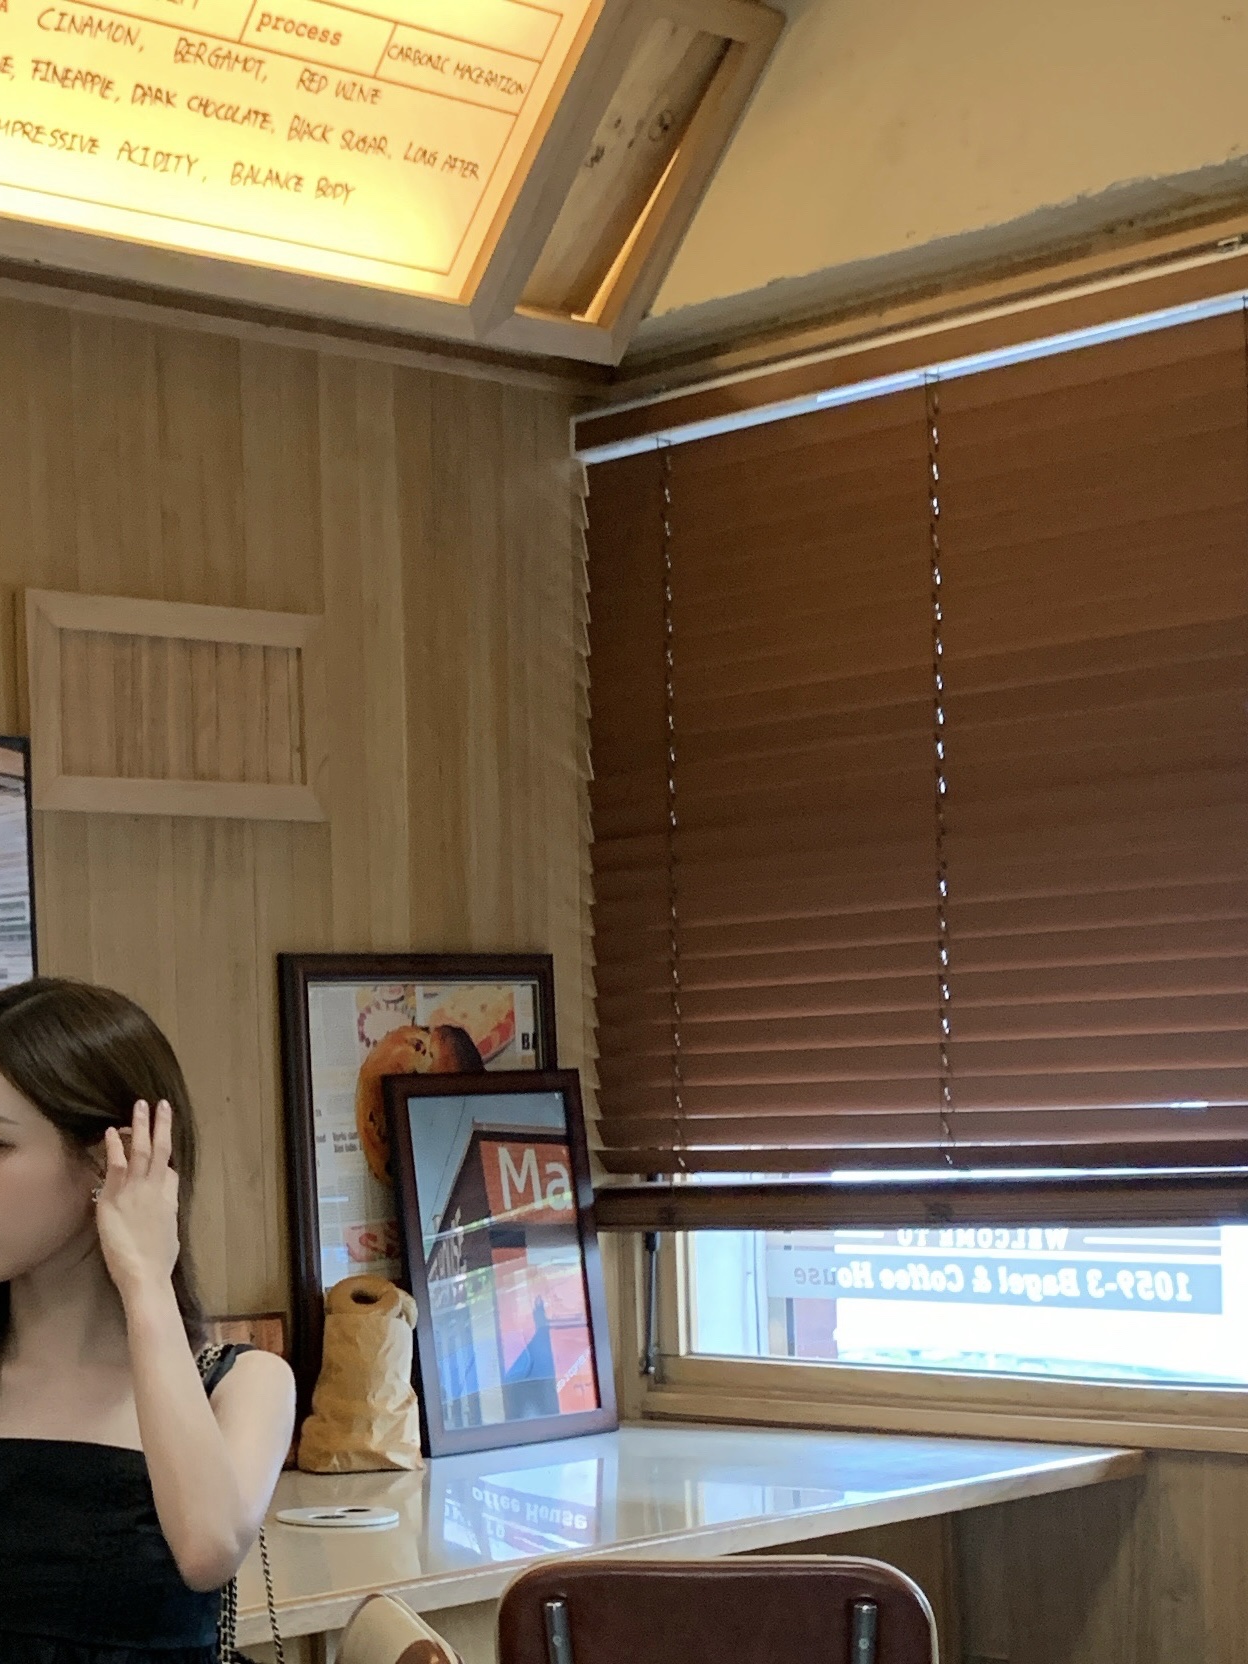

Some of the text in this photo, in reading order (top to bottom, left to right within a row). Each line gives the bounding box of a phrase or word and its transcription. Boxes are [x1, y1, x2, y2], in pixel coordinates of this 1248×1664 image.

[257, 12, 342, 46] process
[37, 8, 145, 53] CINAMON,
[173, 36, 268, 84] BERGAMOT,
[296, 67, 329, 95] RED
[335, 79, 382, 106] WINE
[387, 44, 528, 95] CARBONIC MACERATION
[131, 83, 177, 108] DARK
[287, 114, 335, 144] BLACK
[403, 141, 439, 168] LONG
[440, 153, 480, 181] AFTER
[230, 161, 305, 193] BALANCE
[315, 176, 356, 206] BODY
